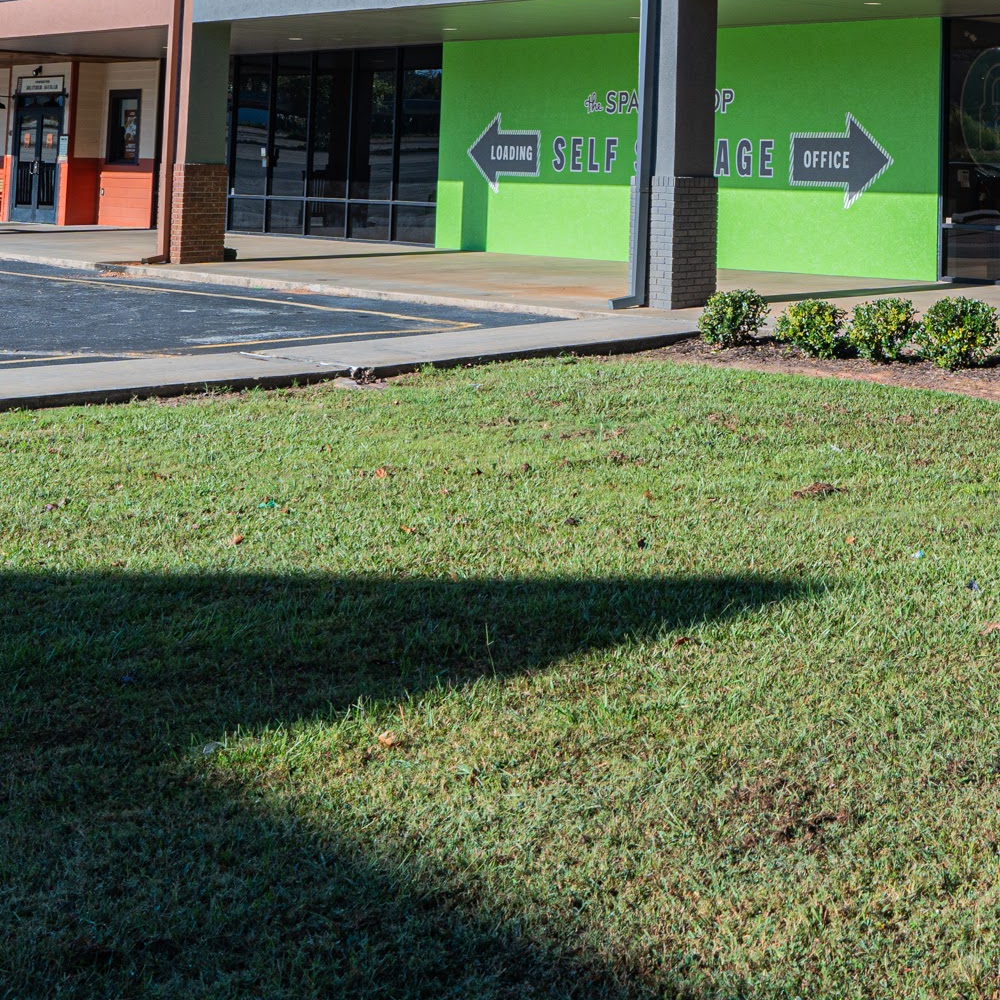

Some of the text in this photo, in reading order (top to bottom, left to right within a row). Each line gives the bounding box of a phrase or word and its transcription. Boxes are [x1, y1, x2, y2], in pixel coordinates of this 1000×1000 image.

[584, 88, 734, 115] the SPA OP
[490, 144, 533, 163] LOADING
[552, 135, 619, 174] SELF
[803, 150, 851, 170] OFFICE
